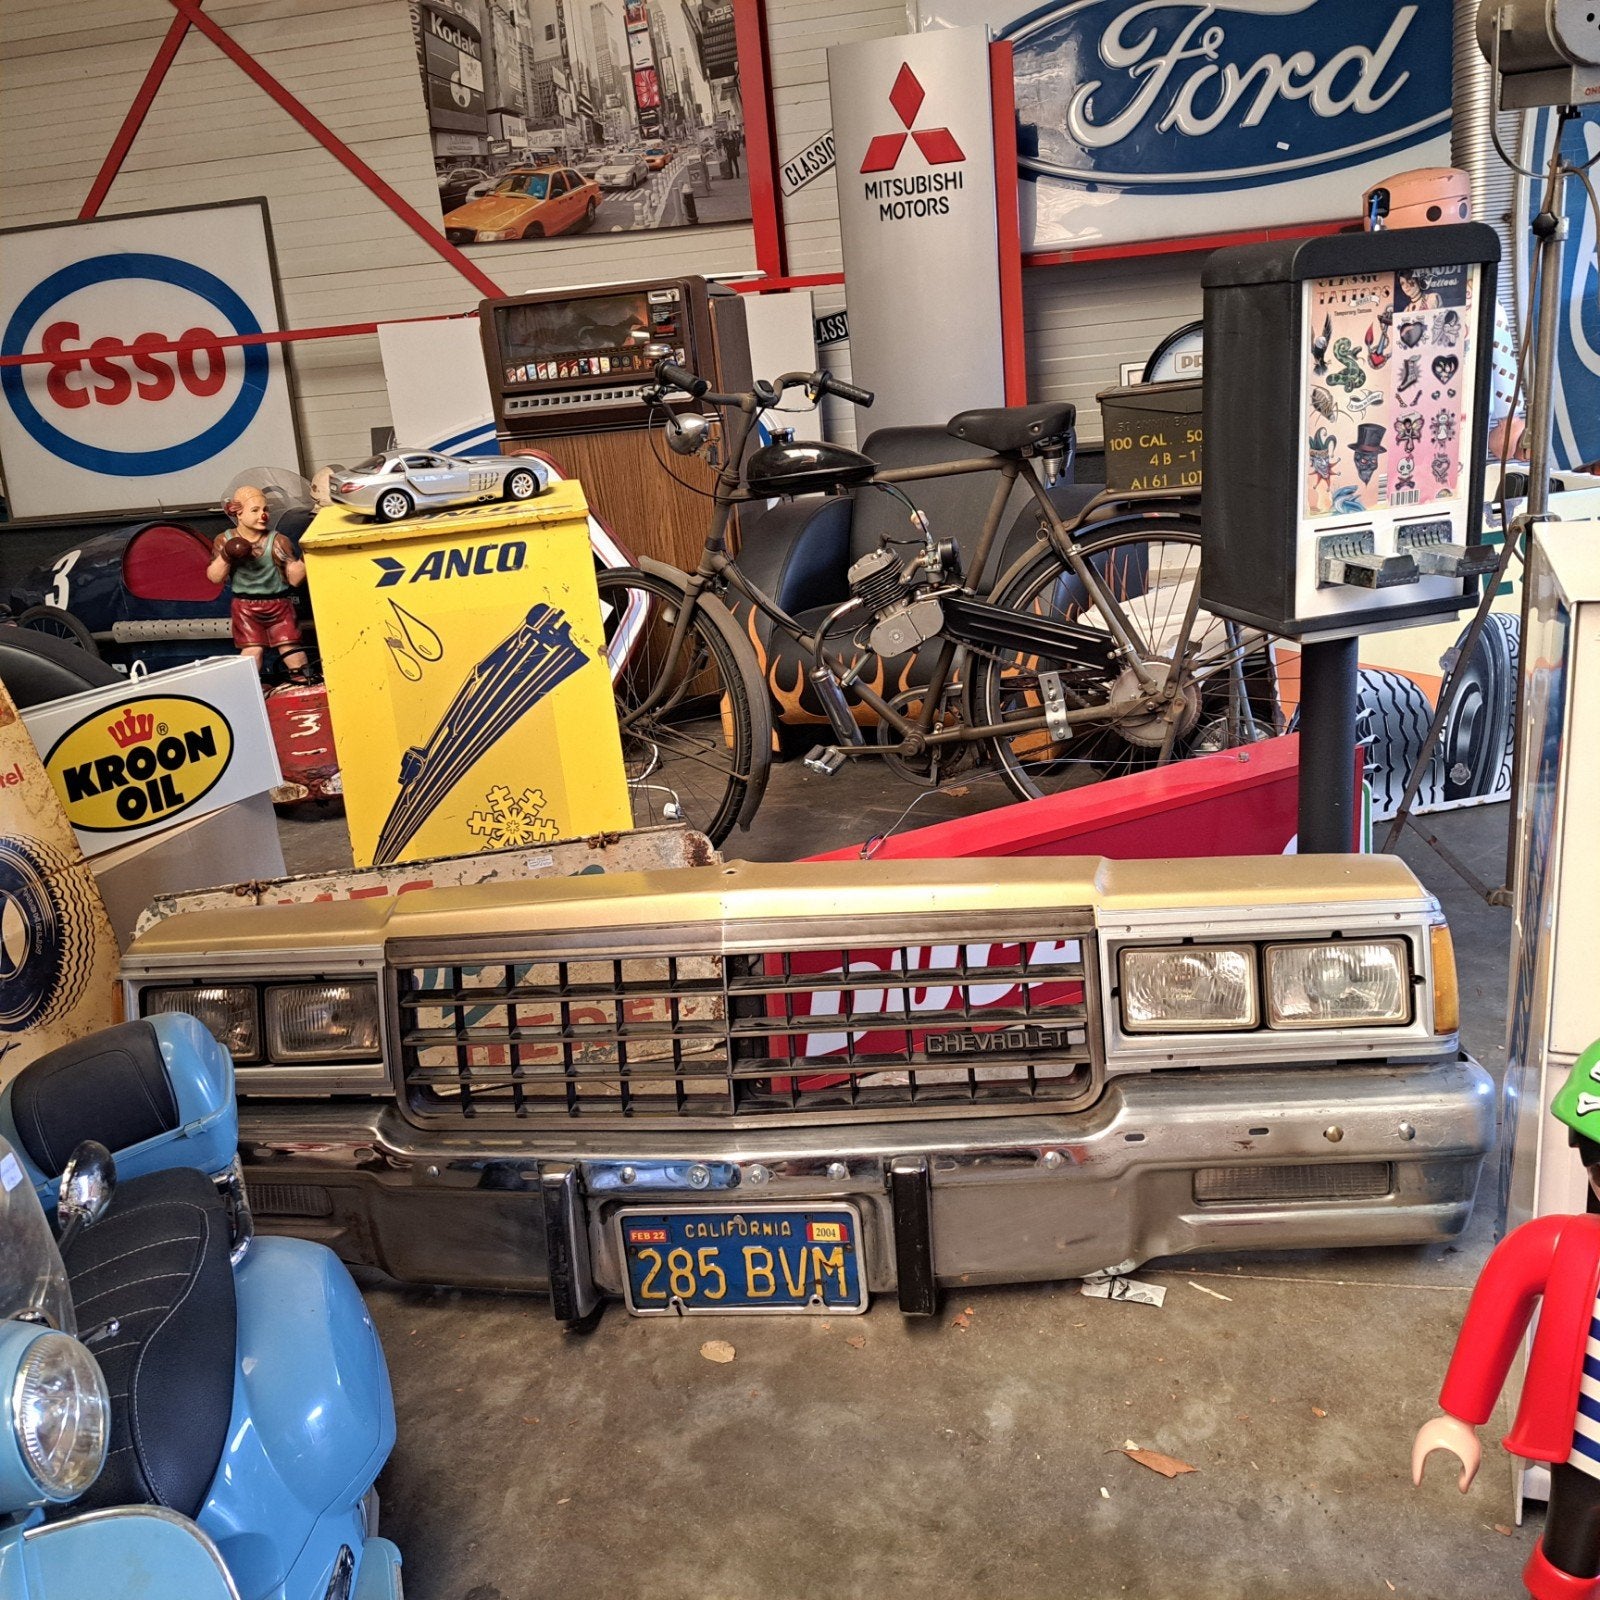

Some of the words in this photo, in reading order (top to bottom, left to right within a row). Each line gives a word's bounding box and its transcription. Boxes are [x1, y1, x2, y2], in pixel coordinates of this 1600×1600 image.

[430, 11, 477, 58] Kodak
[1065, 0, 1418, 149] Ford
[864, 171, 964, 201] MITSUBISHI
[879, 196, 950, 222] MOTORS
[1109, 436, 1133, 451] 100
[44, 549, 82, 611] 3
[408, 540, 527, 584] ANCO
[62, 725, 218, 803] KROON
[116, 773, 186, 821] OIL
[926, 1030, 1067, 1055] CHEVROLET
[631, 1232, 652, 1240] FEB
[652, 1231, 665, 1240] 22
[685, 1219, 793, 1239] CALIFORNIA
[814, 1226, 837, 1238] 2004
[637, 1247, 727, 1299] 285
[741, 1246, 849, 1299] BVM
